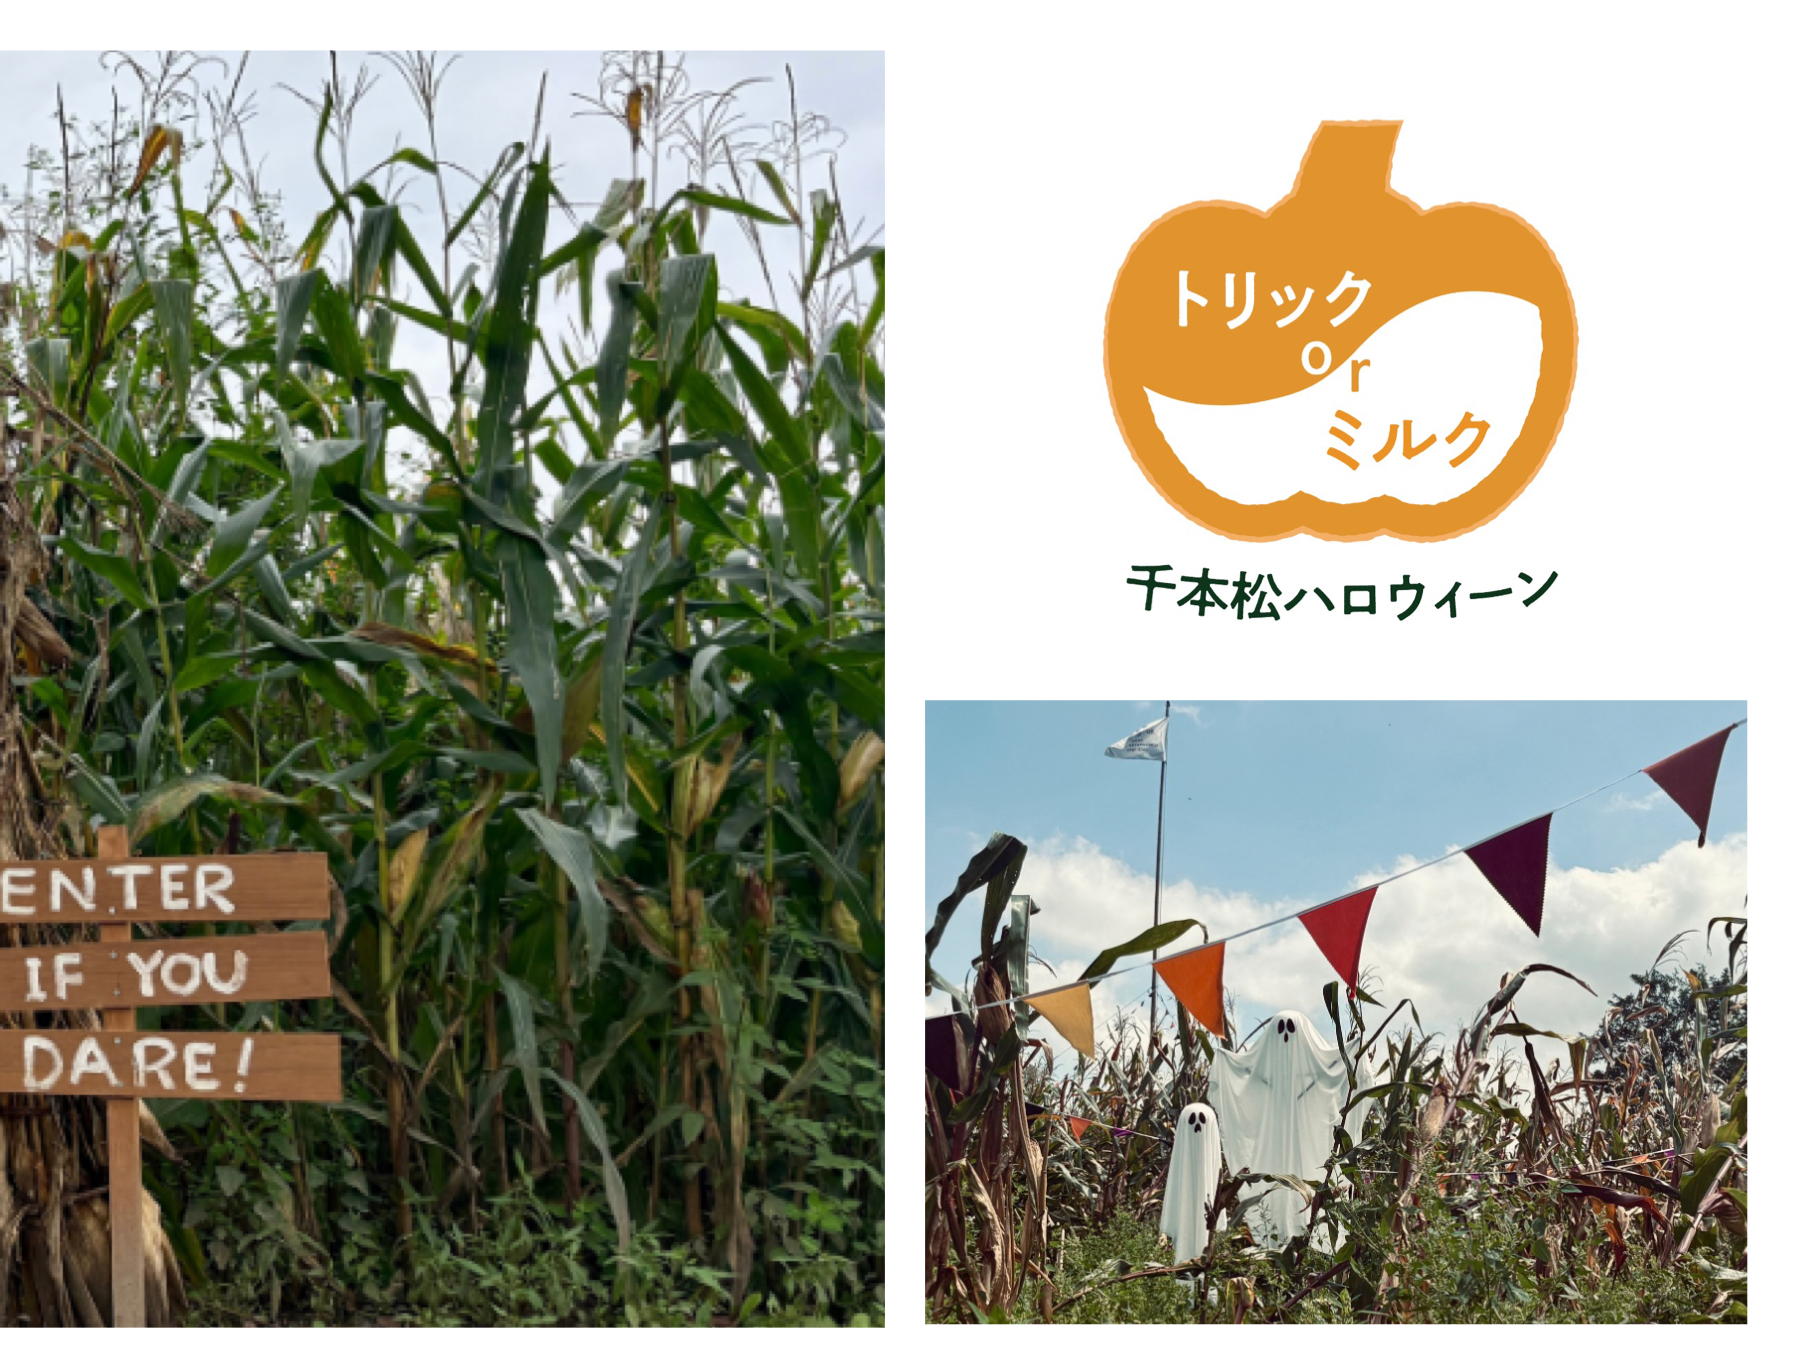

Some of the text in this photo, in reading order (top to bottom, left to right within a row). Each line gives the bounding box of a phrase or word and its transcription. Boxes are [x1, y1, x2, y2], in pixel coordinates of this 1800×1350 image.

[0, 863, 236, 915] ENTER
[24, 949, 249, 1002] IF YOU
[22, 1035, 255, 1093] DARE!
